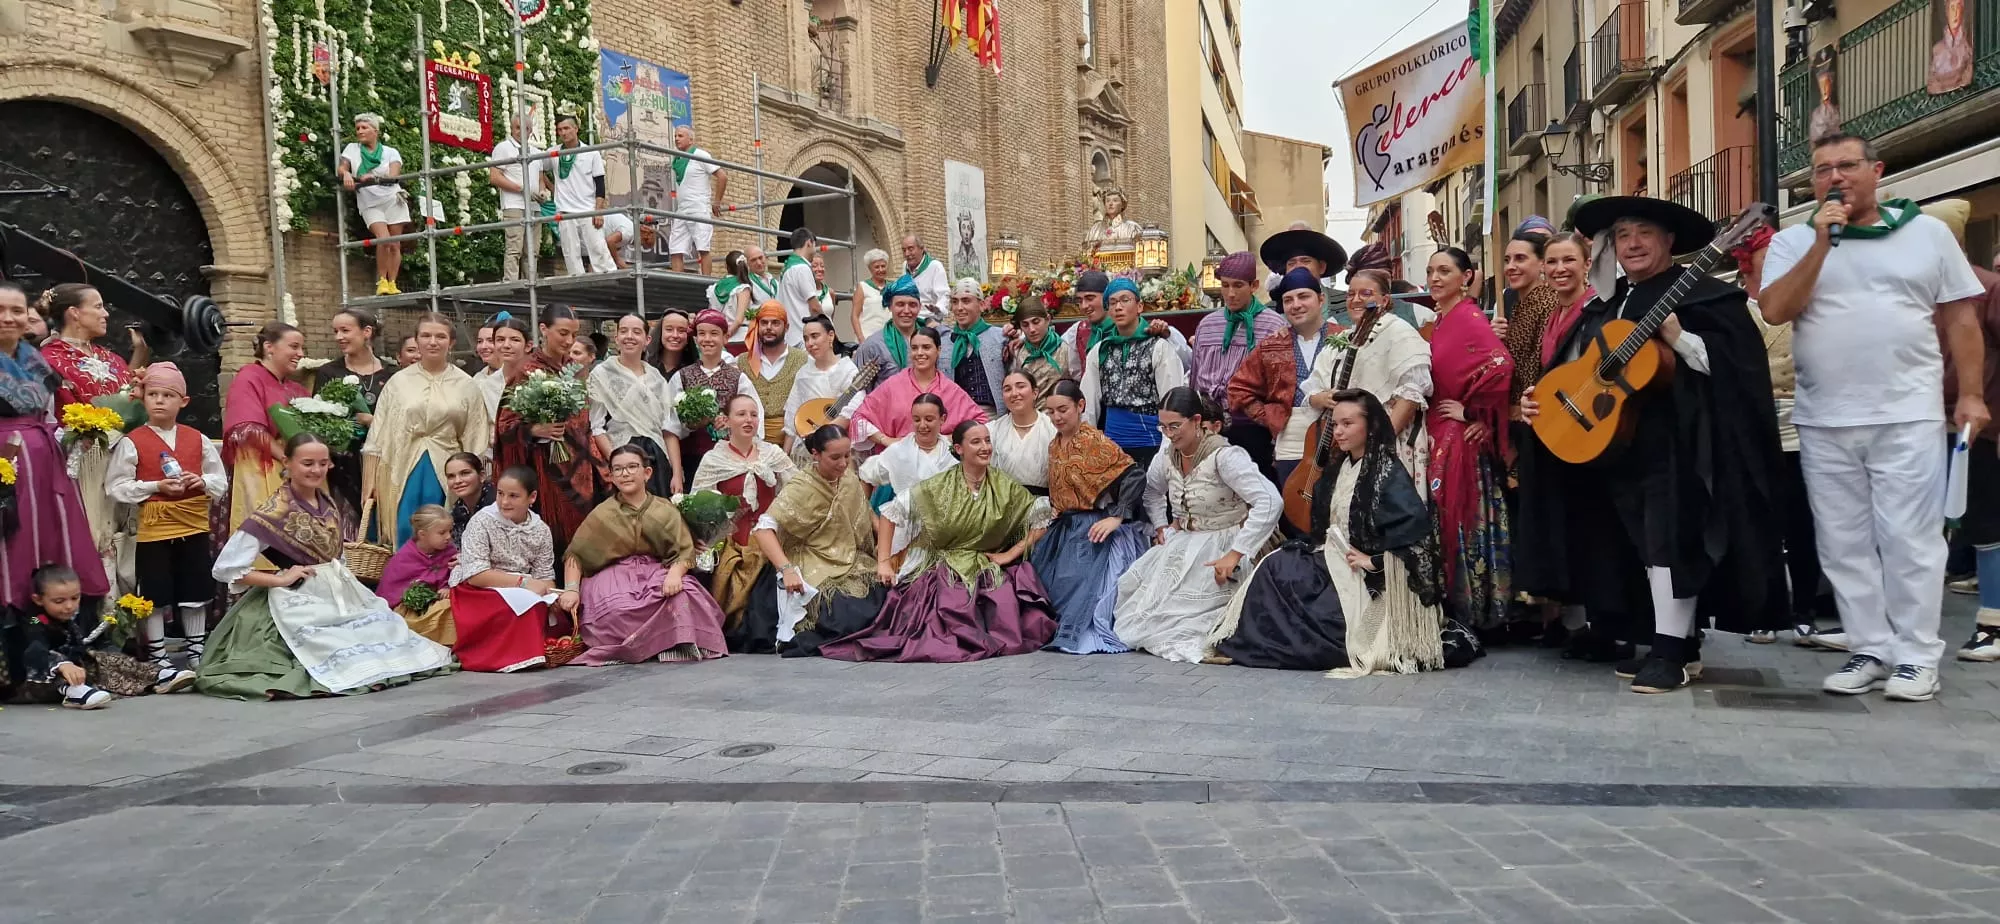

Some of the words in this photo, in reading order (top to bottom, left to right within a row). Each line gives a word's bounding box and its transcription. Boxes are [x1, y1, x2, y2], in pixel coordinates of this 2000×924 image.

[434, 63, 480, 82] RECREATIVA
[1355, 70, 1391, 97] GRUPO
[1391, 34, 1467, 79] FOLKLÓRICO
[1381, 55, 1476, 152] elenco
[1393, 123, 1484, 176] aragonés
